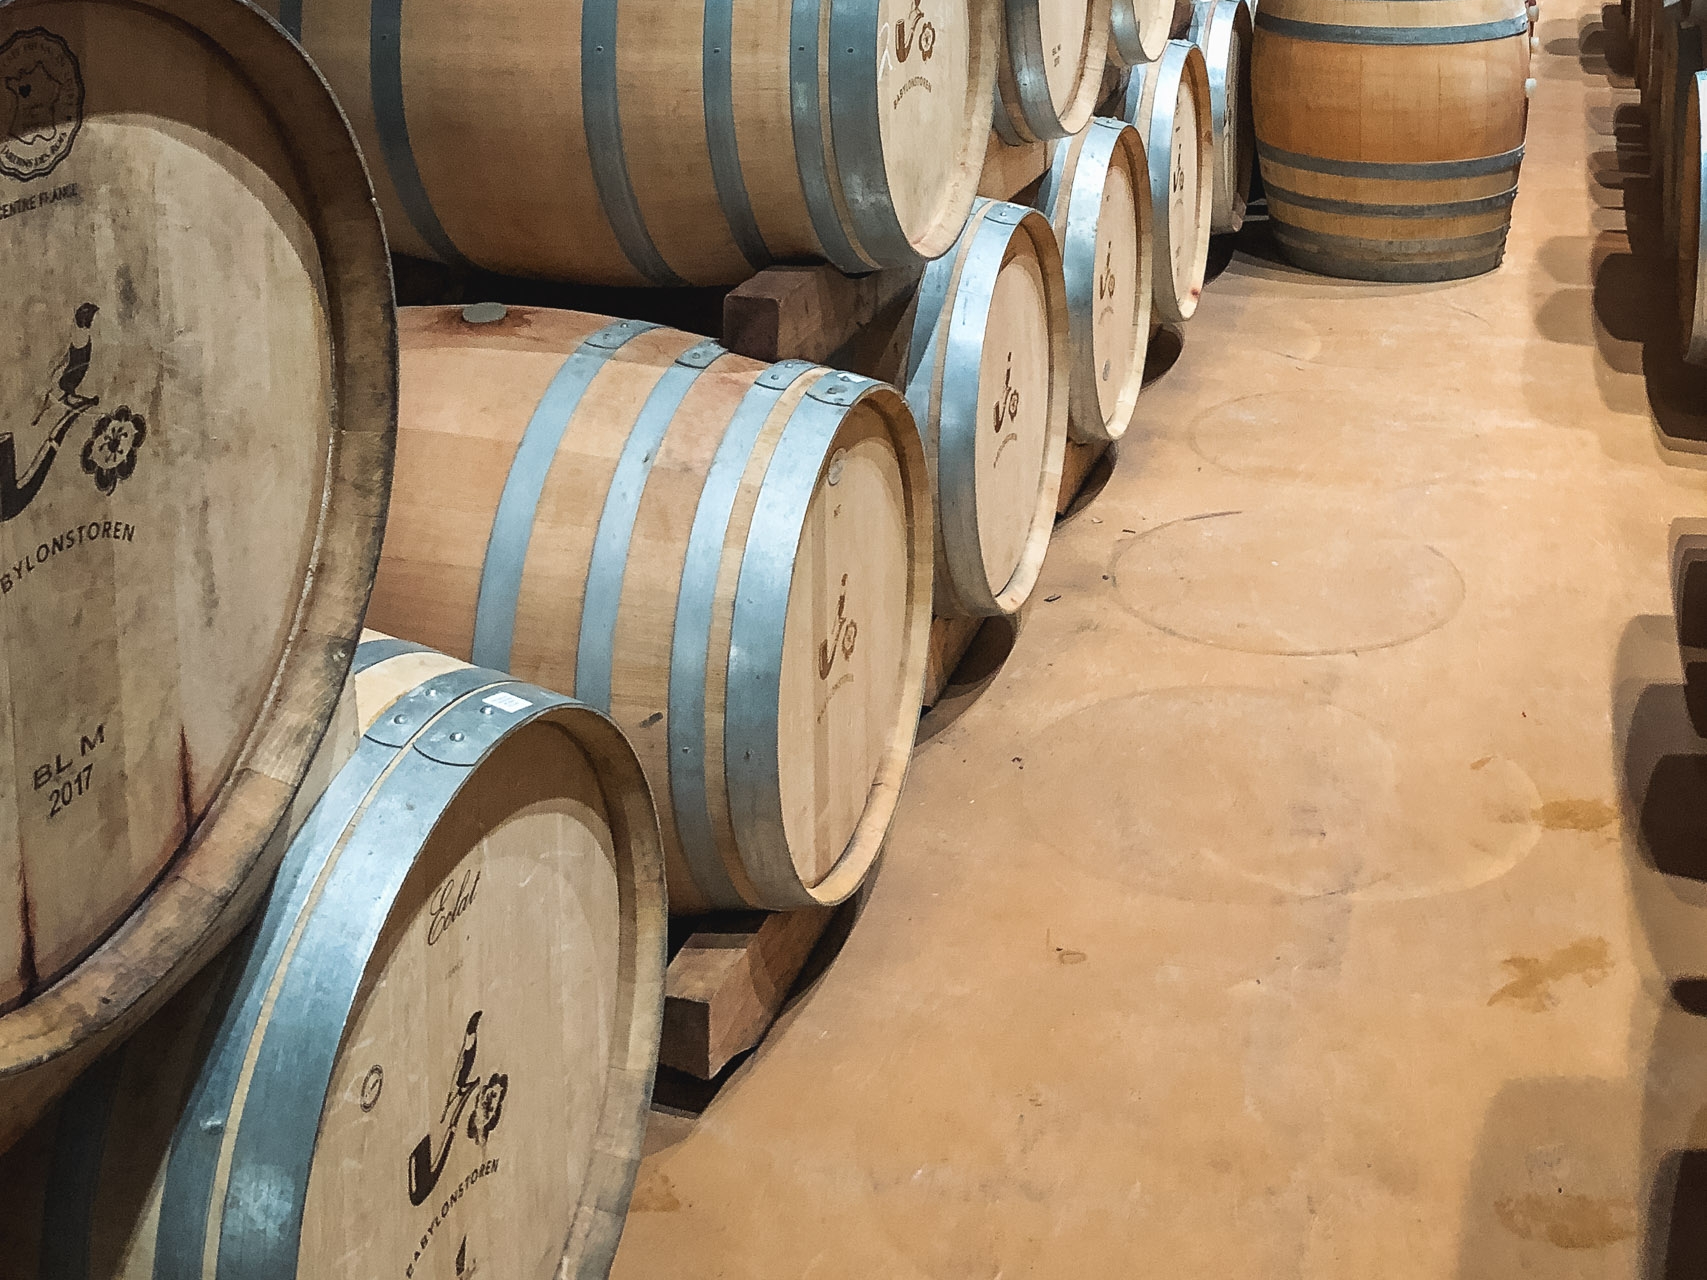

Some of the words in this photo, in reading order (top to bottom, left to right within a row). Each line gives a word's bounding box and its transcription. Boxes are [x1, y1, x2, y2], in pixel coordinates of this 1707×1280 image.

[33, 753, 73, 791] BL
[81, 723, 104, 757] M
[48, 763, 94, 817] 2017
